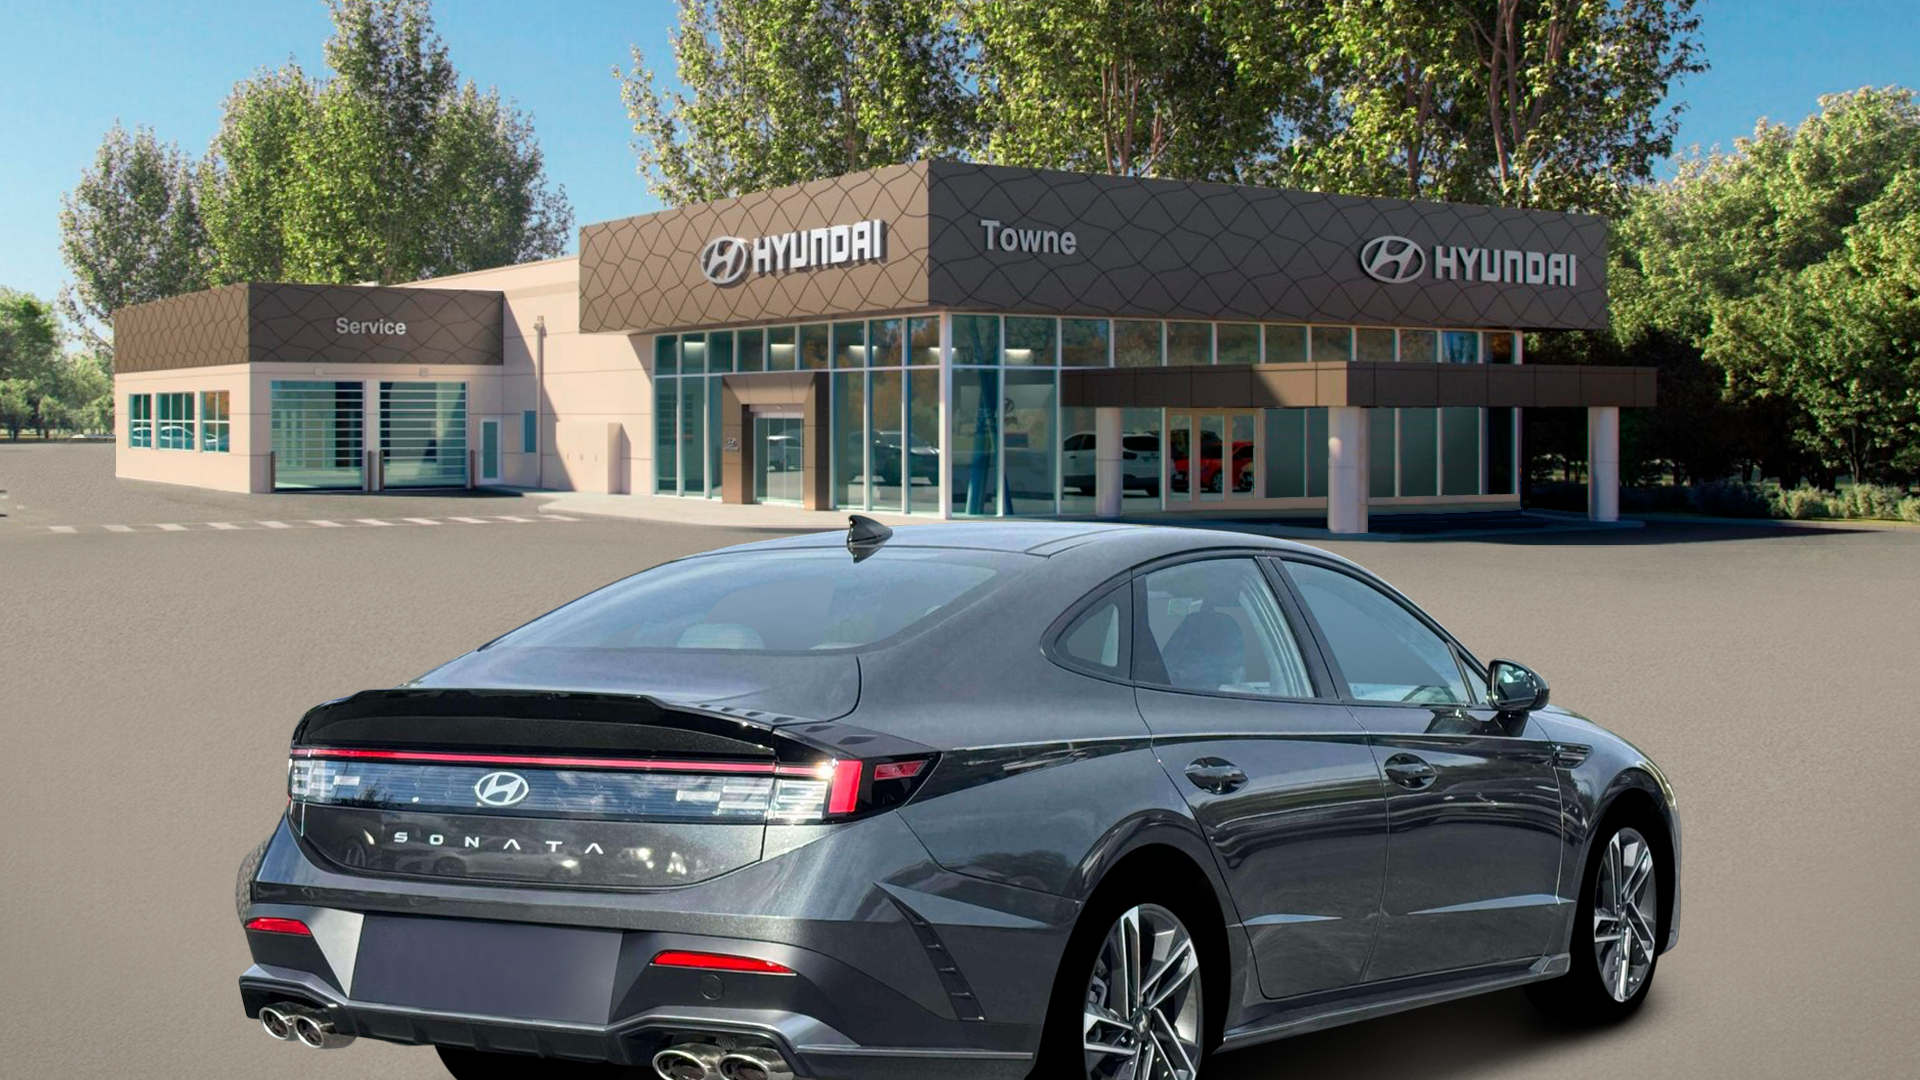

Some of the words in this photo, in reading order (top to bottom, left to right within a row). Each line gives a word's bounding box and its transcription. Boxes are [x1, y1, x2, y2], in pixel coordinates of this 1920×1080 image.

[753, 219, 882, 273] HYUNDAI
[980, 219, 1077, 255] Towne
[1434, 245, 1577, 287] HYUNDAI
[335, 317, 407, 335] Service
[394, 831, 604, 855] SONATA
